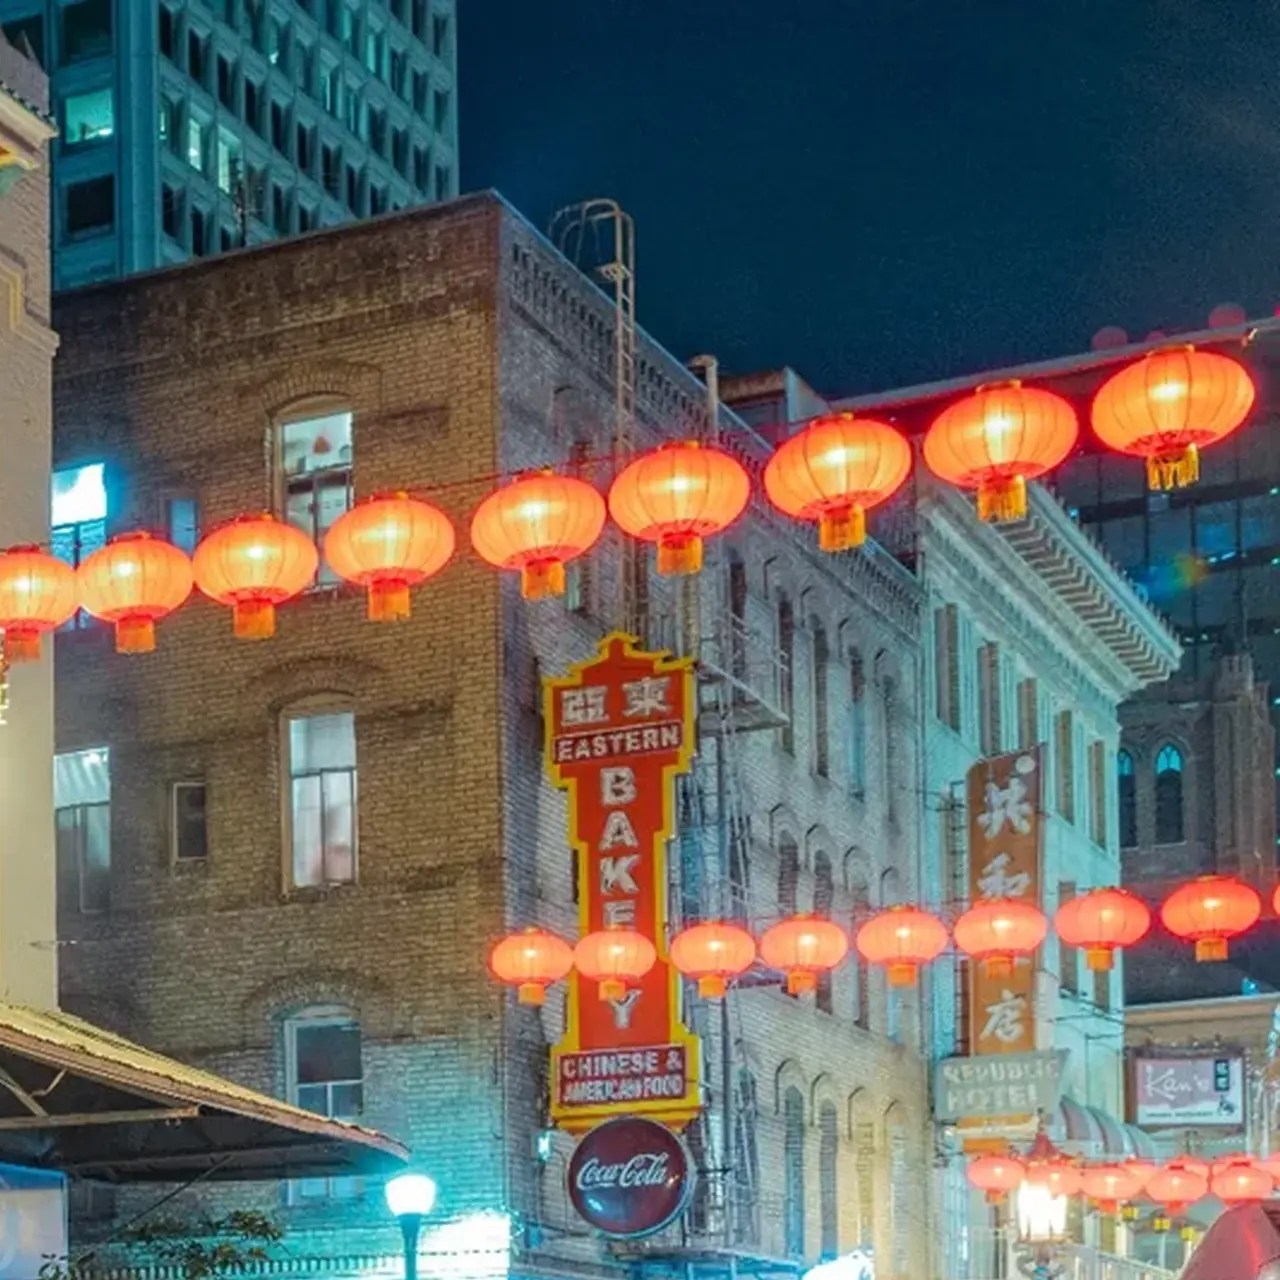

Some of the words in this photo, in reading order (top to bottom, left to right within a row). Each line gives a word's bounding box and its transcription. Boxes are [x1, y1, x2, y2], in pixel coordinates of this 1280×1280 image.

[558, 724, 679, 762] EASTERN
[598, 766, 643, 1029] BAKEY
[977, 778, 1032, 1043] 共和店
[562, 1053, 659, 1078] CHINESE
[666, 1051, 684, 1071] &
[563, 1076, 640, 1102] AMERICAN
[644, 1073, 684, 1097] FOOD
[947, 1084, 1040, 1113] HOTEL
[576, 1152, 670, 1191] Coca-Cola
